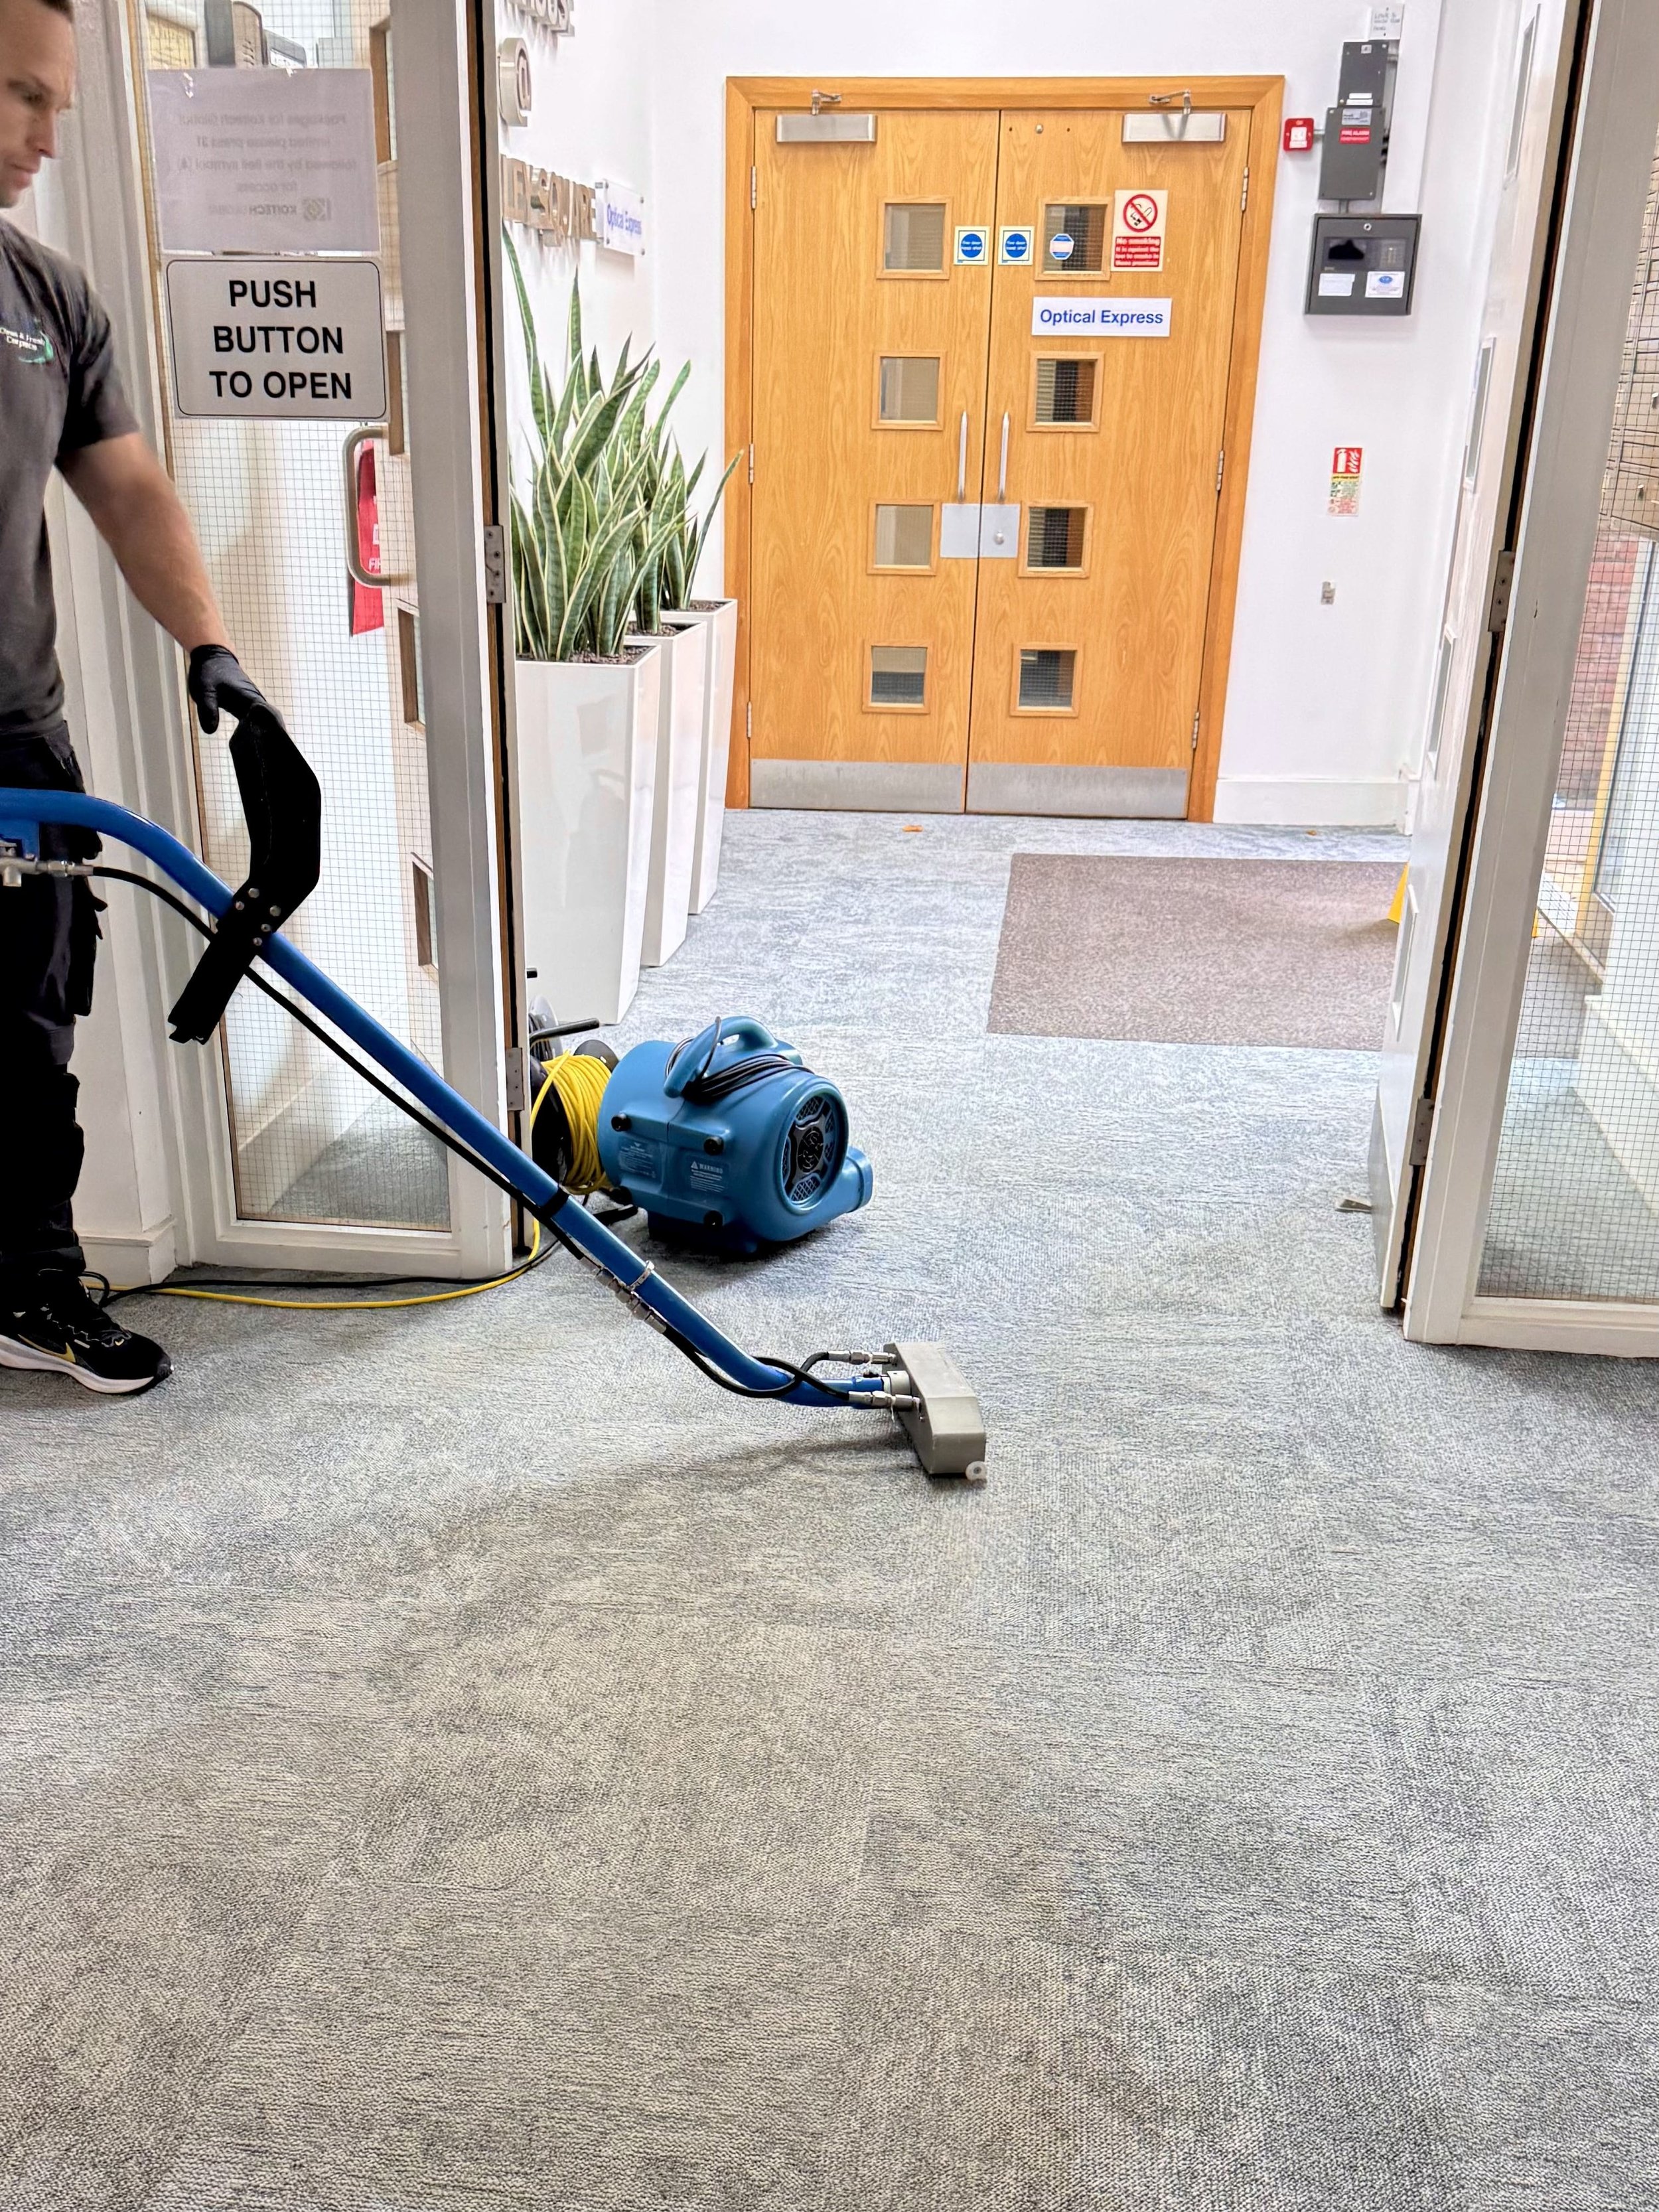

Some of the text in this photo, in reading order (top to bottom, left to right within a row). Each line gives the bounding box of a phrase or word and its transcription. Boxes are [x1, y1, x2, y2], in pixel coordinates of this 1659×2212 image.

[229, 280, 316, 308] PUSH
[1040, 309, 1164, 327] Optical Express
[214, 326, 344, 354] BUTTON
[209, 370, 352, 399] TO OPEN
